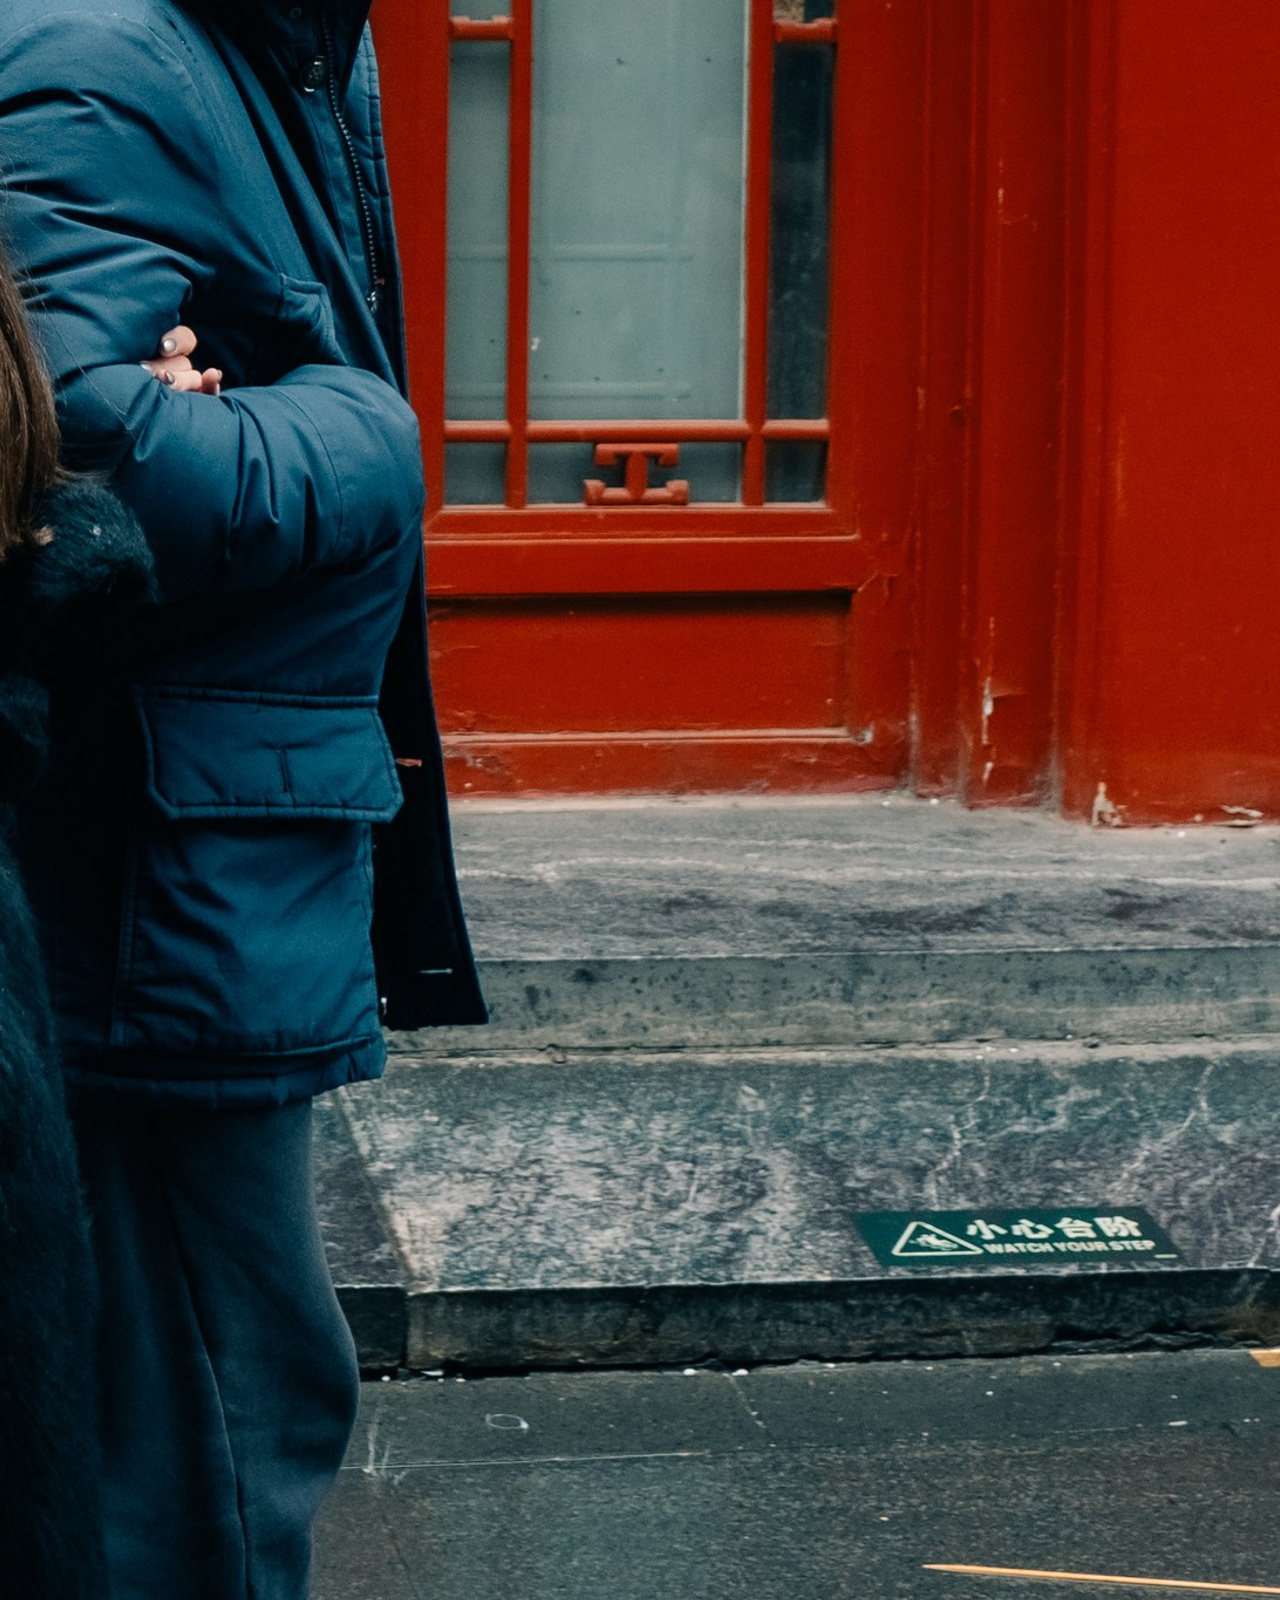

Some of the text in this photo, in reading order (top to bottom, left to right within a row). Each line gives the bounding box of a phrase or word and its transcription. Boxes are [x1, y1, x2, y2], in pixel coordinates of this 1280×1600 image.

[966, 1215, 1144, 1240] 小心台阶
[984, 1240, 1156, 1255] WATCH YOUR STEP
